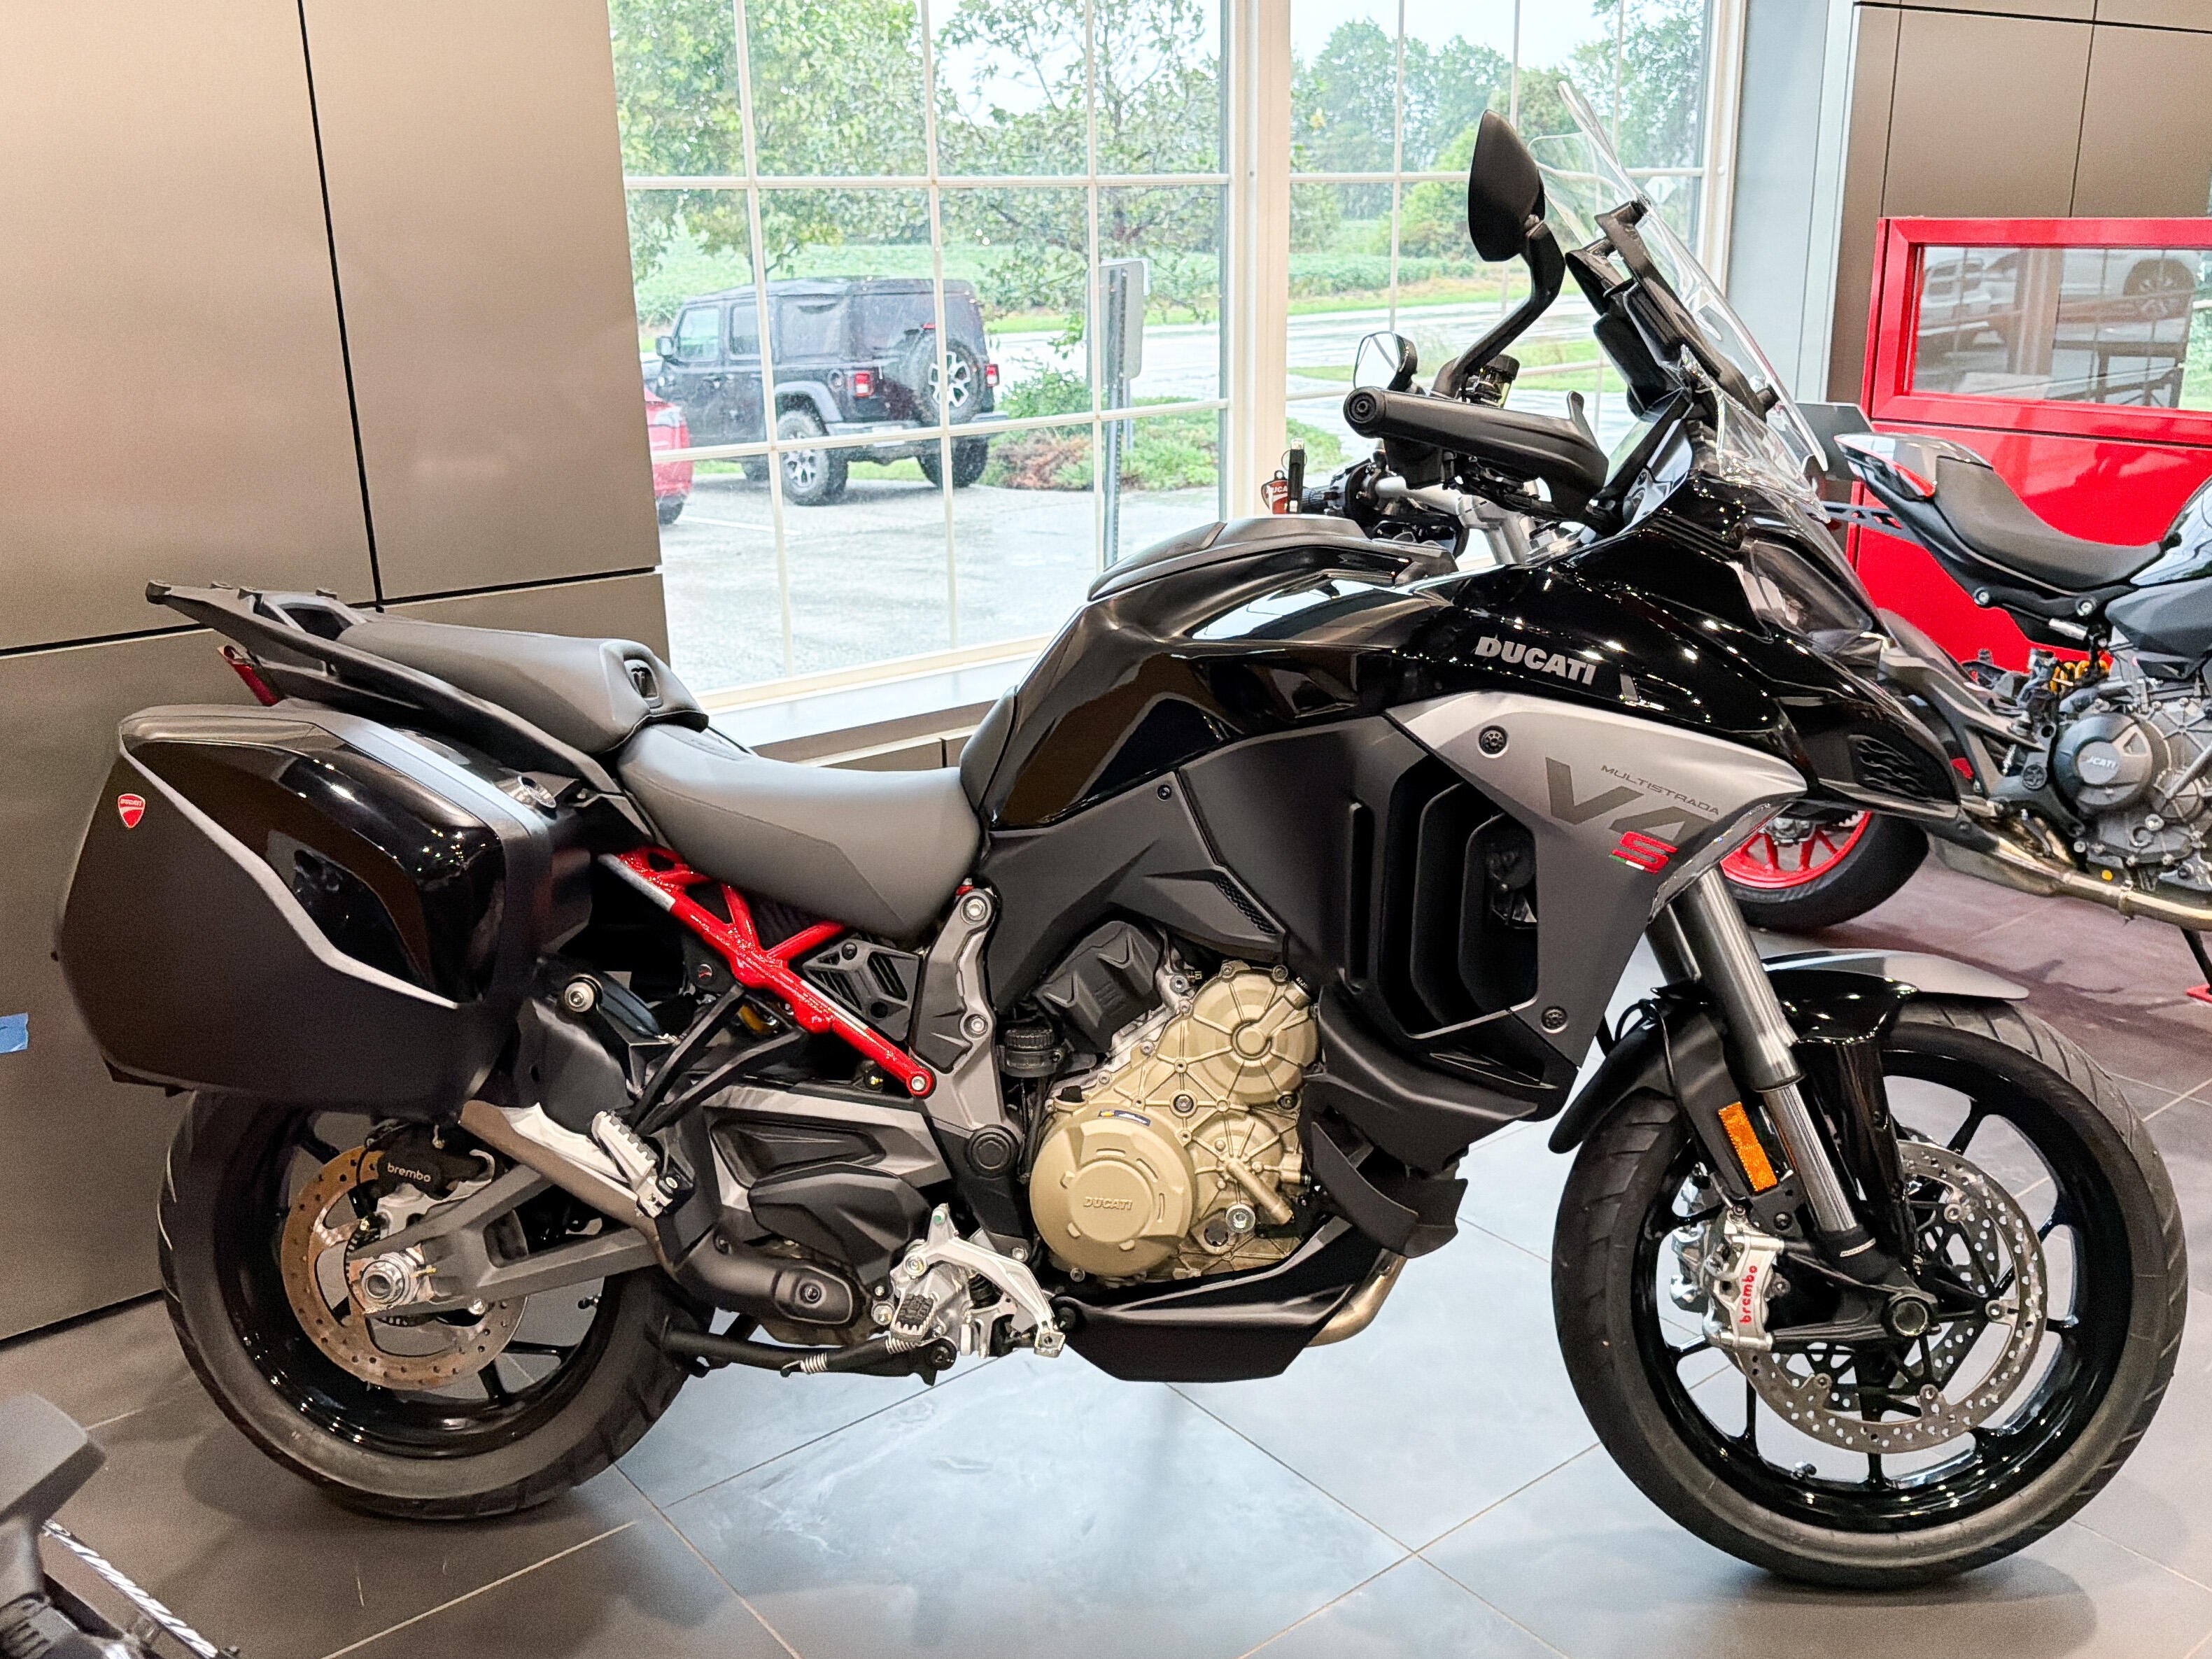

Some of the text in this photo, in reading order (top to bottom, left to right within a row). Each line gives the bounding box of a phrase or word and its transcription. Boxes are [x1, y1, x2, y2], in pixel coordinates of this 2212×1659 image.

[1474, 636, 1597, 686] DUCATI
[1545, 757, 1716, 845] V4
[1600, 765, 1719, 815] MULTISTRADA
[1612, 831, 1678, 874] S
[388, 1162, 431, 1183] brembo
[1083, 1196, 1133, 1210] DUCATI
[1740, 1265, 1758, 1324] brembo
